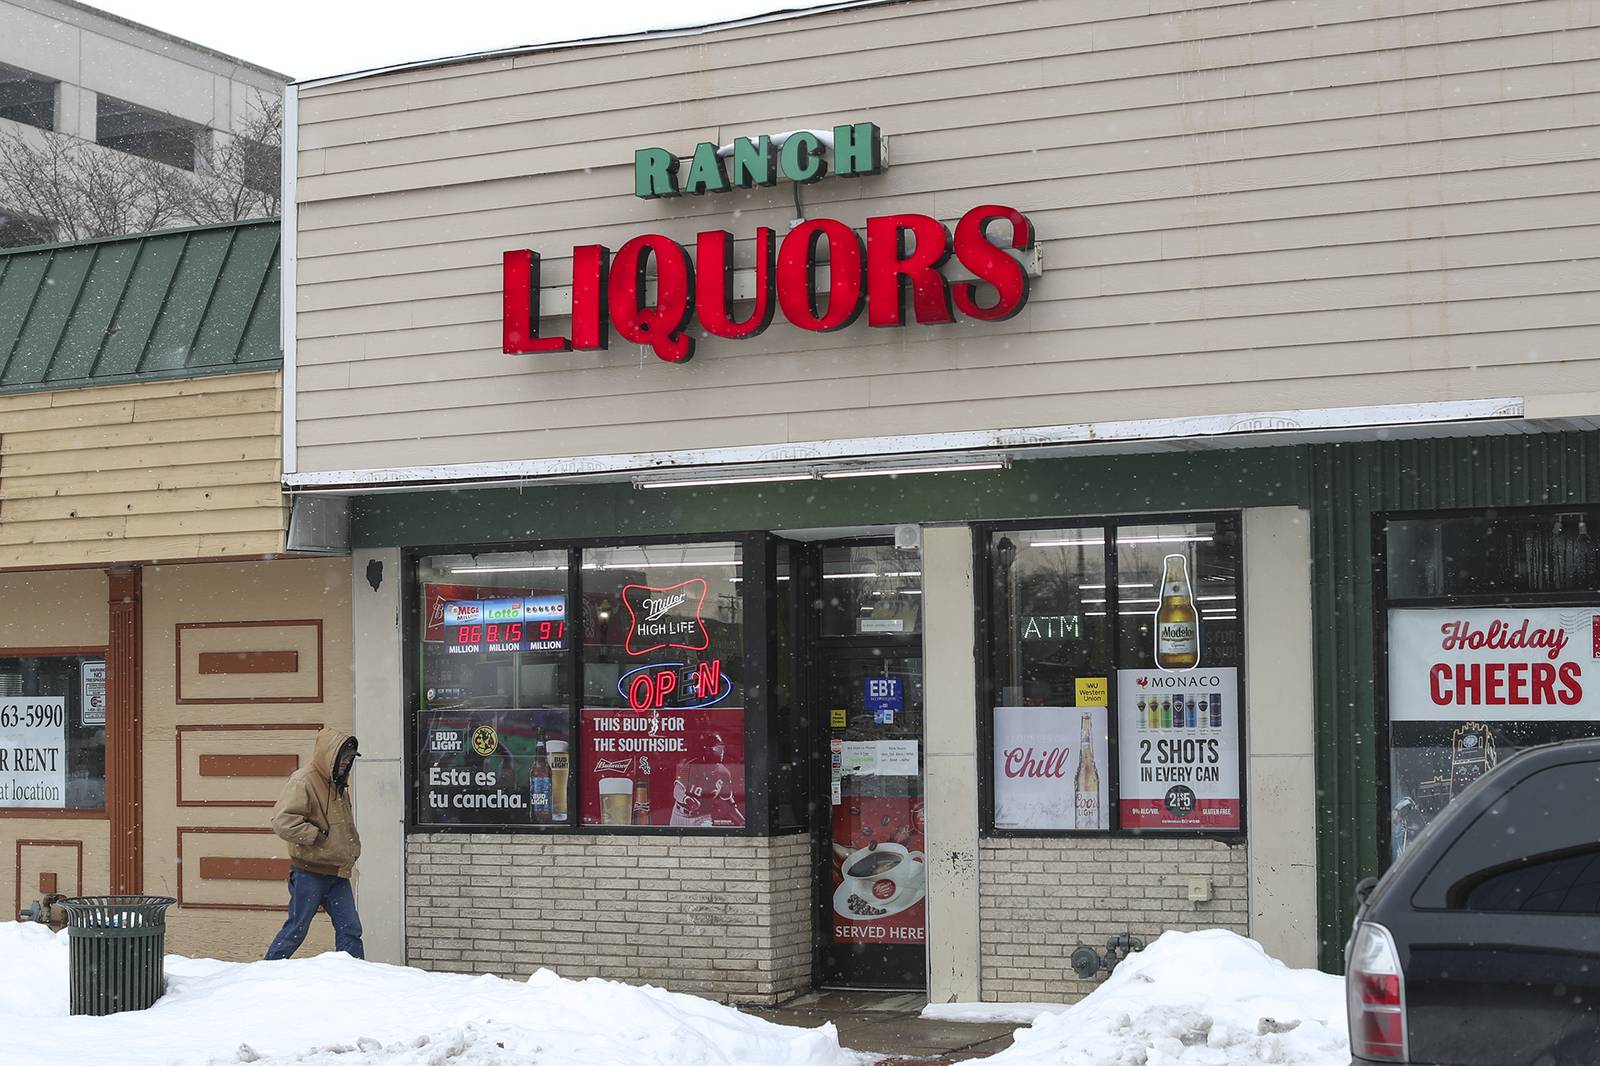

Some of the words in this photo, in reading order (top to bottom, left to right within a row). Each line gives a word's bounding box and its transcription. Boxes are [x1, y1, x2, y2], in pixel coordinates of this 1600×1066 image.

[635, 121, 881, 199] RANCH
[503, 204, 1035, 363] LIQUORS
[642, 593, 686, 616] Miller
[488, 609, 519, 619] Lotto
[459, 626, 482, 643] 86
[486, 623, 522, 642] 8.15
[540, 622, 564, 641] 91
[638, 623, 666, 636] HIGH
[670, 621, 695, 634] LIFE
[1024, 614, 1080, 638] ATM
[1162, 626, 1192, 638] Modelo
[489, 642, 520, 652] MILLION
[530, 641, 562, 650] MILLION
[1440, 619, 1569, 660] Holiday
[449, 645, 480, 653] MILLION
[629, 660, 720, 713] OPEN
[870, 680, 896, 696] EBT
[1152, 676, 1220, 688] MONACO
[1429, 661, 1583, 706] CHEERS
[0, 704, 63, 728] 63-5990
[594, 717, 620, 731] THIS
[623, 717, 658, 731] BUD'
[662, 717, 685, 731] FOR
[436, 732, 458, 741] BUD
[594, 738, 615, 752] THE
[618, 738, 688, 752] SOUTHSIDE.
[432, 741, 462, 750] LIGHT
[1140, 739, 1151, 764] 2
[1157, 739, 1219, 764] SHOTS
[14, 748, 58, 772] RENT
[1004, 747, 1070, 778] Chill
[429, 762, 470, 786] Ésta
[475, 771, 496, 786] es
[1141, 767, 1152, 782] IN
[1156, 767, 1192, 782] EVERY
[1196, 767, 1219, 782] CAN
[12, 778, 60, 800] location
[428, 791, 448, 808] tu
[453, 790, 527, 808] cancha.
[1170, 792, 1176, 807] 2
[836, 926, 886, 937] SERVED
[890, 926, 924, 939] HERE
